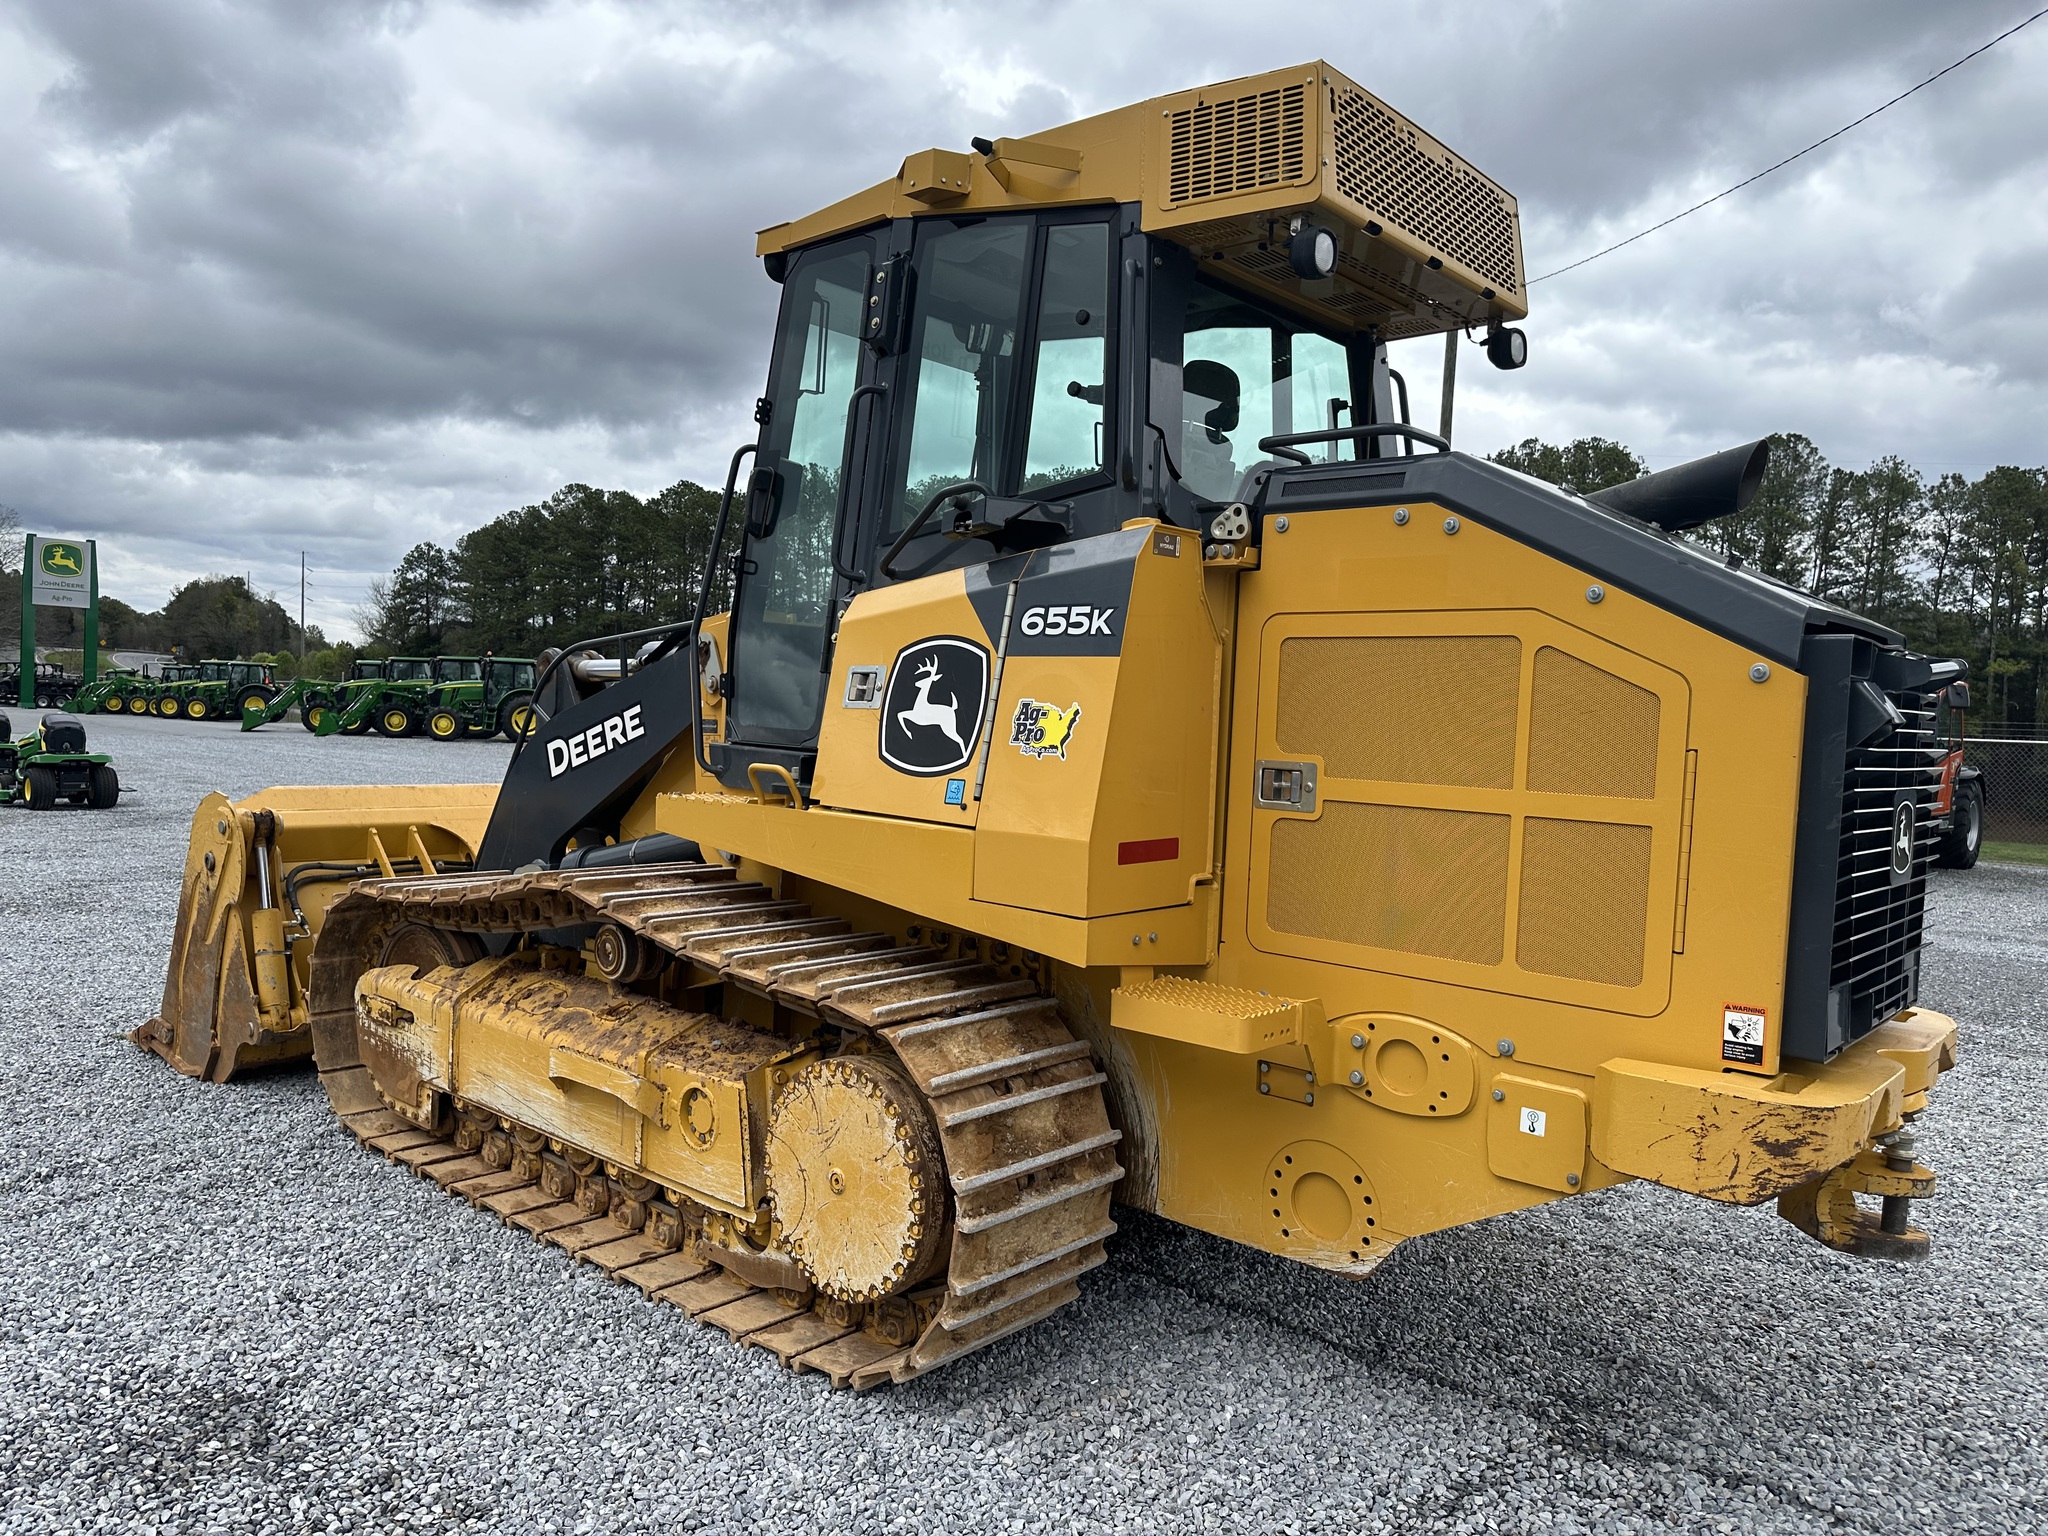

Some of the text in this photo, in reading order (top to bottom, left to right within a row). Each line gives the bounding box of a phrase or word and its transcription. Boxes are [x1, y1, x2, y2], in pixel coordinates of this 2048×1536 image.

[61, 581, 85, 589] DEERE
[52, 594, 73, 602] Ag-Pro
[1021, 606, 1115, 636] 655K
[1015, 702, 1048, 727] Ag-
[546, 704, 645, 778] DEERE
[1012, 722, 1045, 742] Pro
[1731, 1004, 1766, 1015] WARNING
